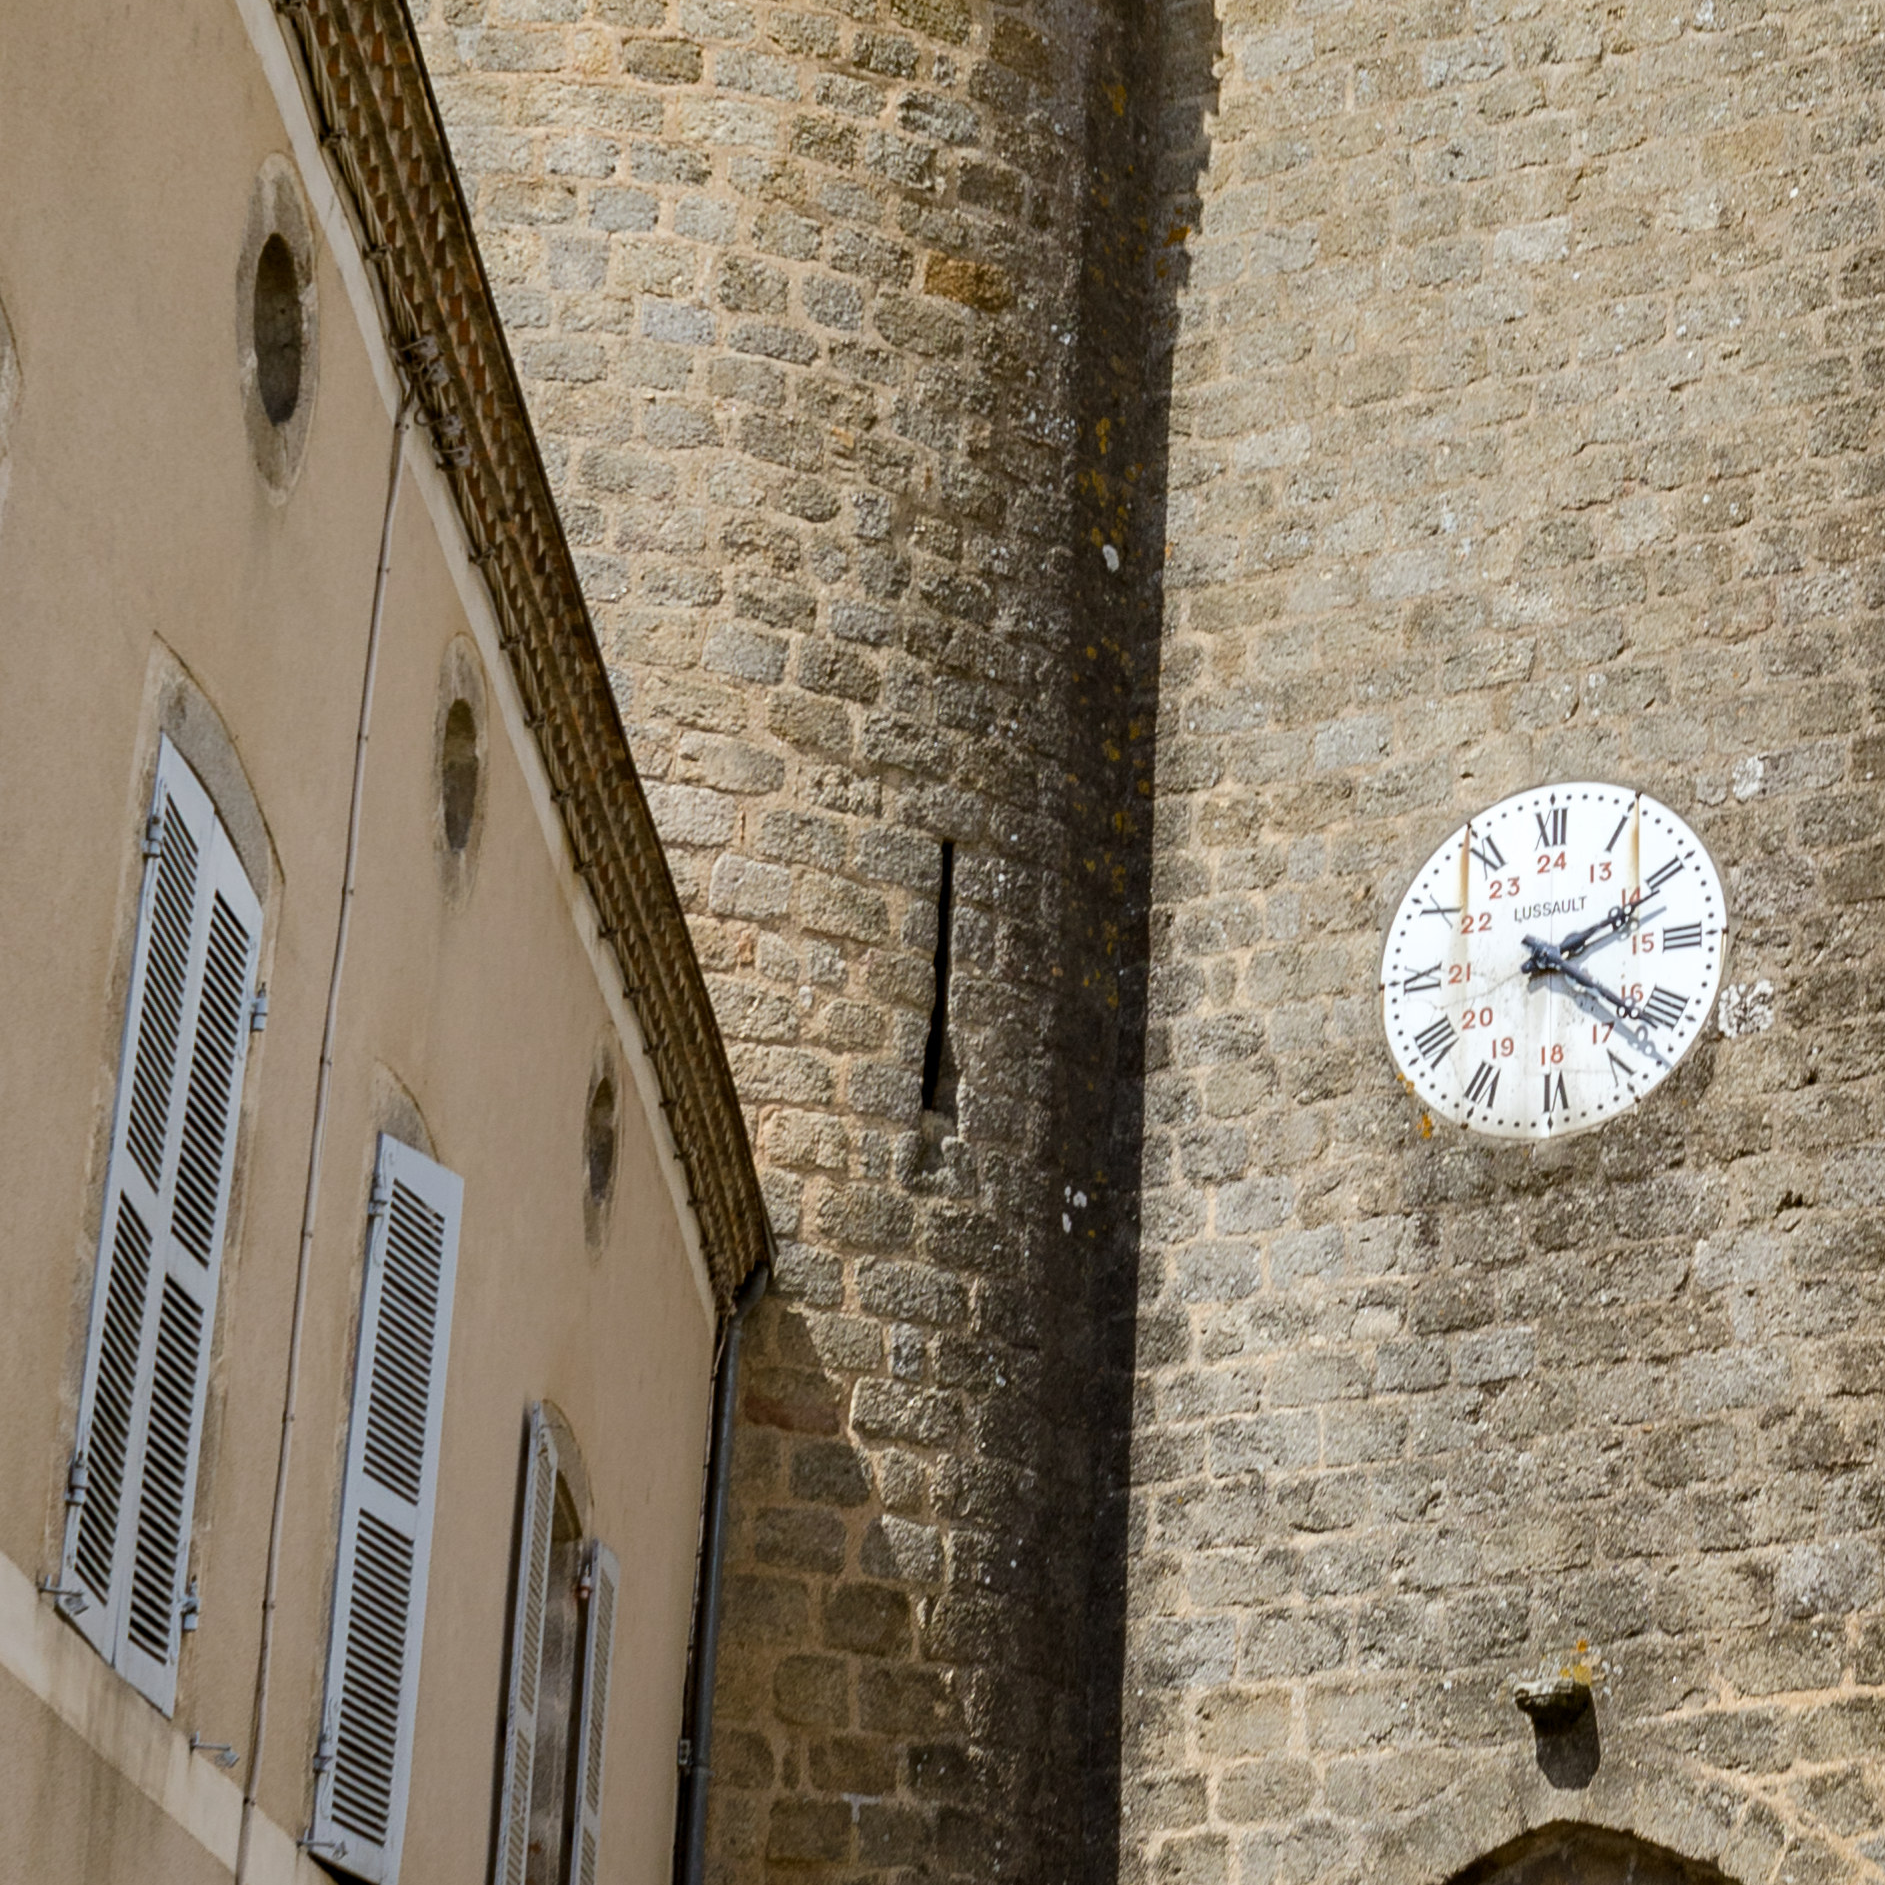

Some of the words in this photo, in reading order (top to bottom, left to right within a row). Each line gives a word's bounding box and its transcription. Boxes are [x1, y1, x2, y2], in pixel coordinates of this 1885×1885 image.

[1535, 807, 1568, 851] XII
[1470, 834, 1507, 881] XI
[1537, 851, 1567, 874] 24
[1590, 861, 1612, 883] 13
[1645, 854, 1686, 892] II
[1489, 876, 1521, 900] 23
[1621, 886, 1641, 908] 14
[1419, 893, 1463, 929] X
[1461, 912, 1492, 935] 22
[1632, 932, 1655, 955] 15
[1662, 920, 1702, 953] III
[1448, 962, 1472, 985] 21
[1621, 983, 1644, 1003] 16
[1461, 1006, 1493, 1031] 20
[1642, 982, 1690, 1032] IIII
[1592, 1022, 1616, 1045] 17
[1492, 1037, 1515, 1059] 19
[1541, 1044, 1564, 1066] 18
[1606, 1048, 1638, 1087] V
